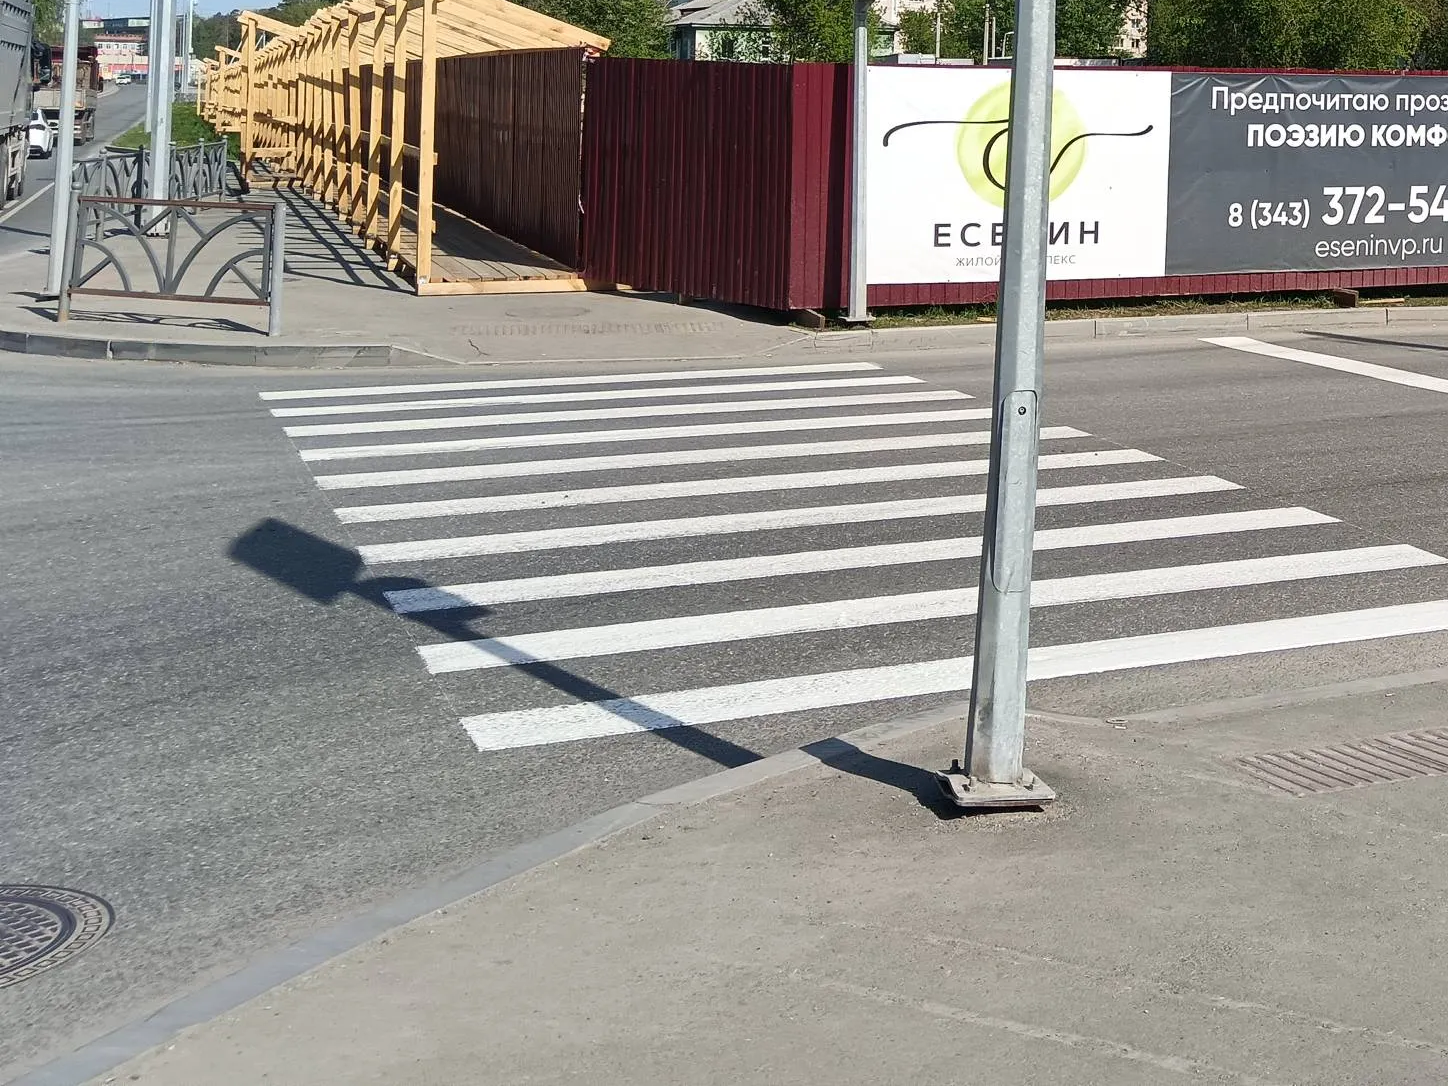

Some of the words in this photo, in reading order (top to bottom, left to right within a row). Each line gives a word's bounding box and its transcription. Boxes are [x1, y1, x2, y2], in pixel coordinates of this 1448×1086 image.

[1211, 86, 1390, 115] Предпочитаю
[1247, 123, 1366, 147] ПОЭЗИЮ
[1228, 202, 1243, 228] 8
[1250, 198, 1310, 230] (343)
[934, 221, 1099, 247] ЕСЕИН
[1315, 233, 1443, 260] eseninvp.ru
